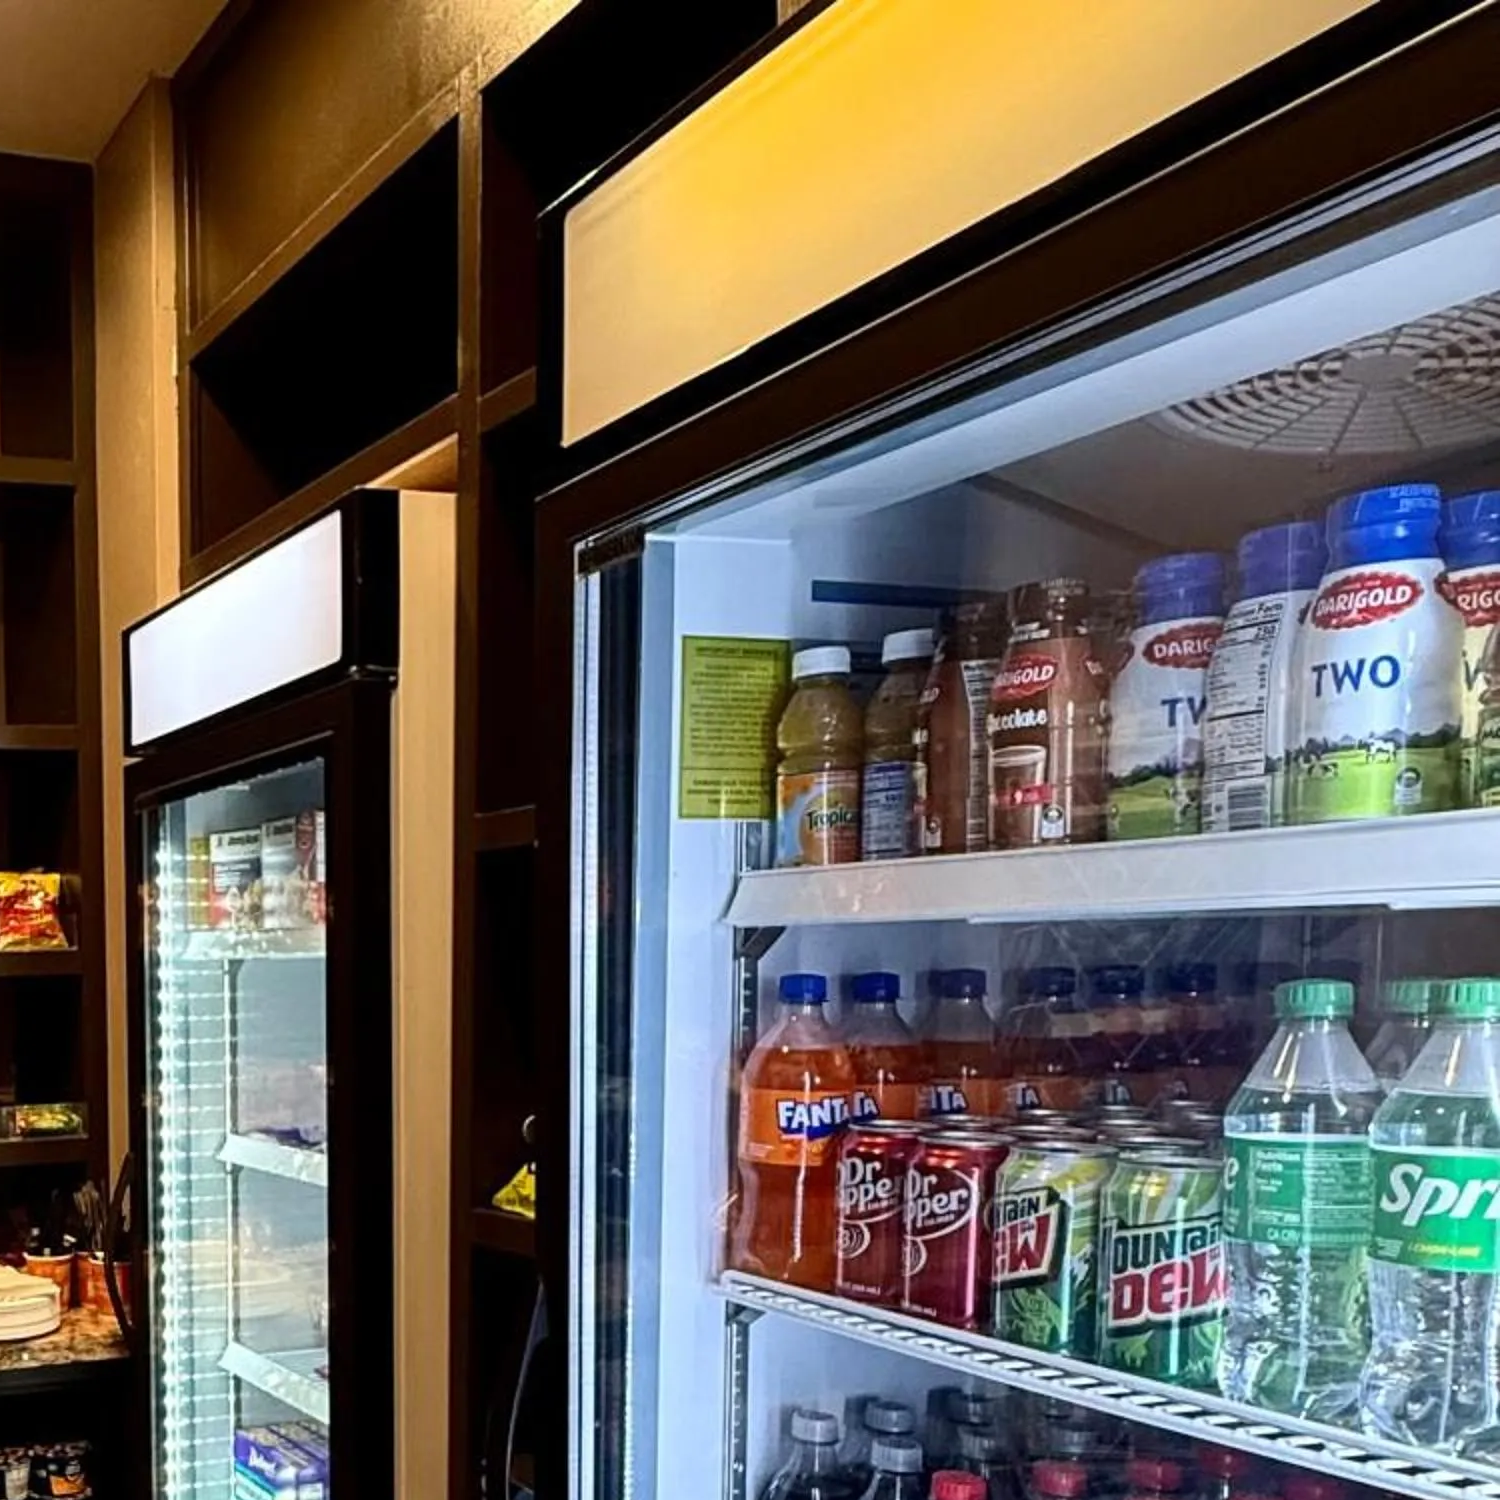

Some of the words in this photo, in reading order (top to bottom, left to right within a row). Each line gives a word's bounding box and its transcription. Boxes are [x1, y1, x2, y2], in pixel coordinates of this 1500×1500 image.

[1315, 585, 1413, 616] DARIGOLD
[1153, 636, 1222, 660] DARIG
[1311, 654, 1401, 698] TWO
[1160, 697, 1208, 729] TW
[843, 1156, 882, 1187] Dr
